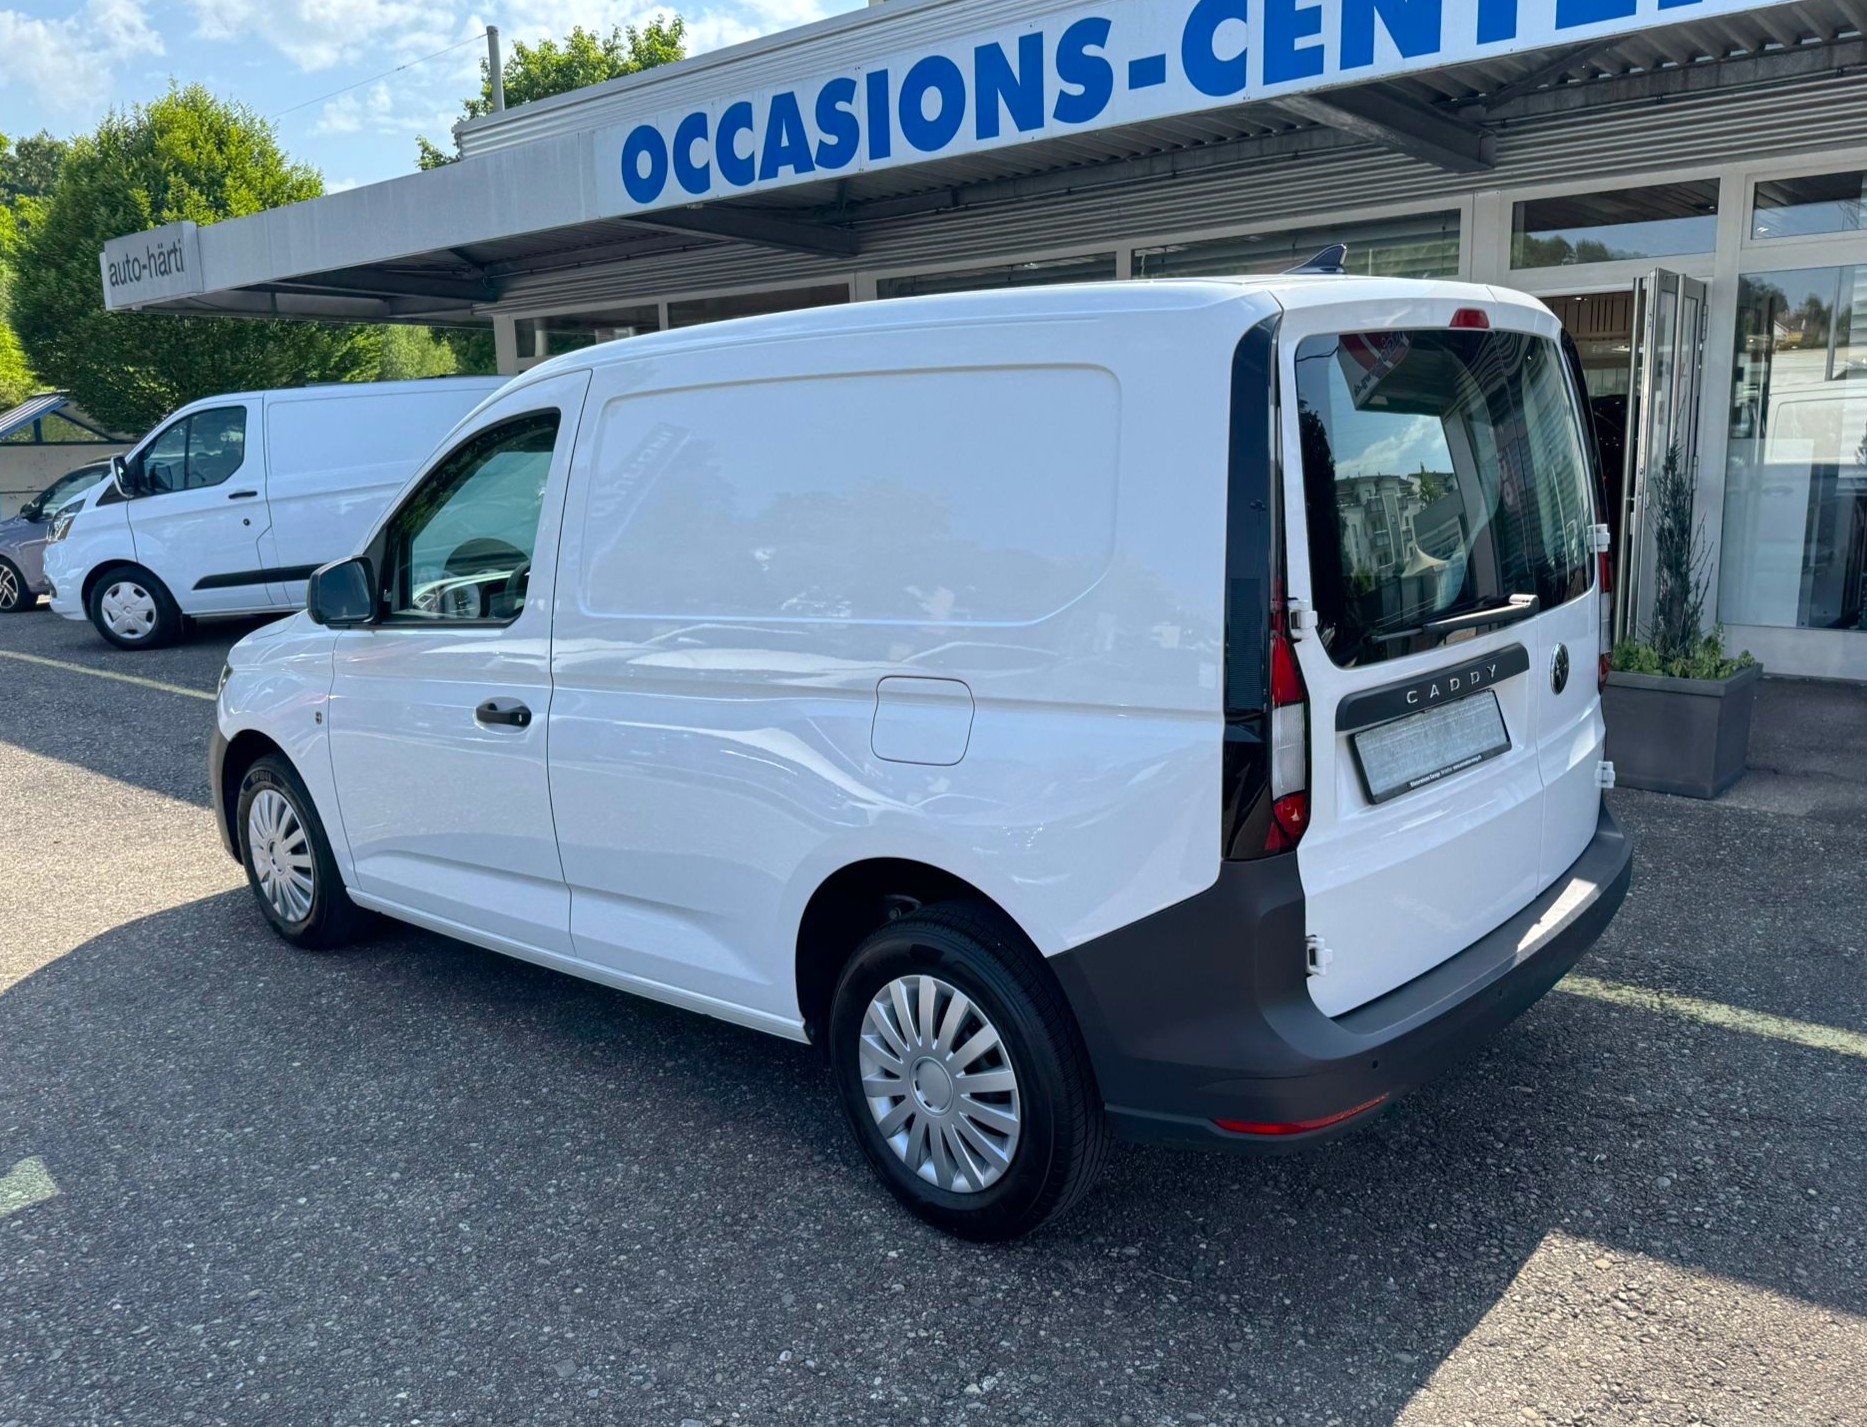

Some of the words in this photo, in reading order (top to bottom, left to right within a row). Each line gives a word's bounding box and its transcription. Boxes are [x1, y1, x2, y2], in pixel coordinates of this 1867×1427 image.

[621, 0, 1704, 203] OCCASIONS-CEN
[108, 239, 184, 287] auto-härti
[1406, 664, 1497, 704] CADDY
